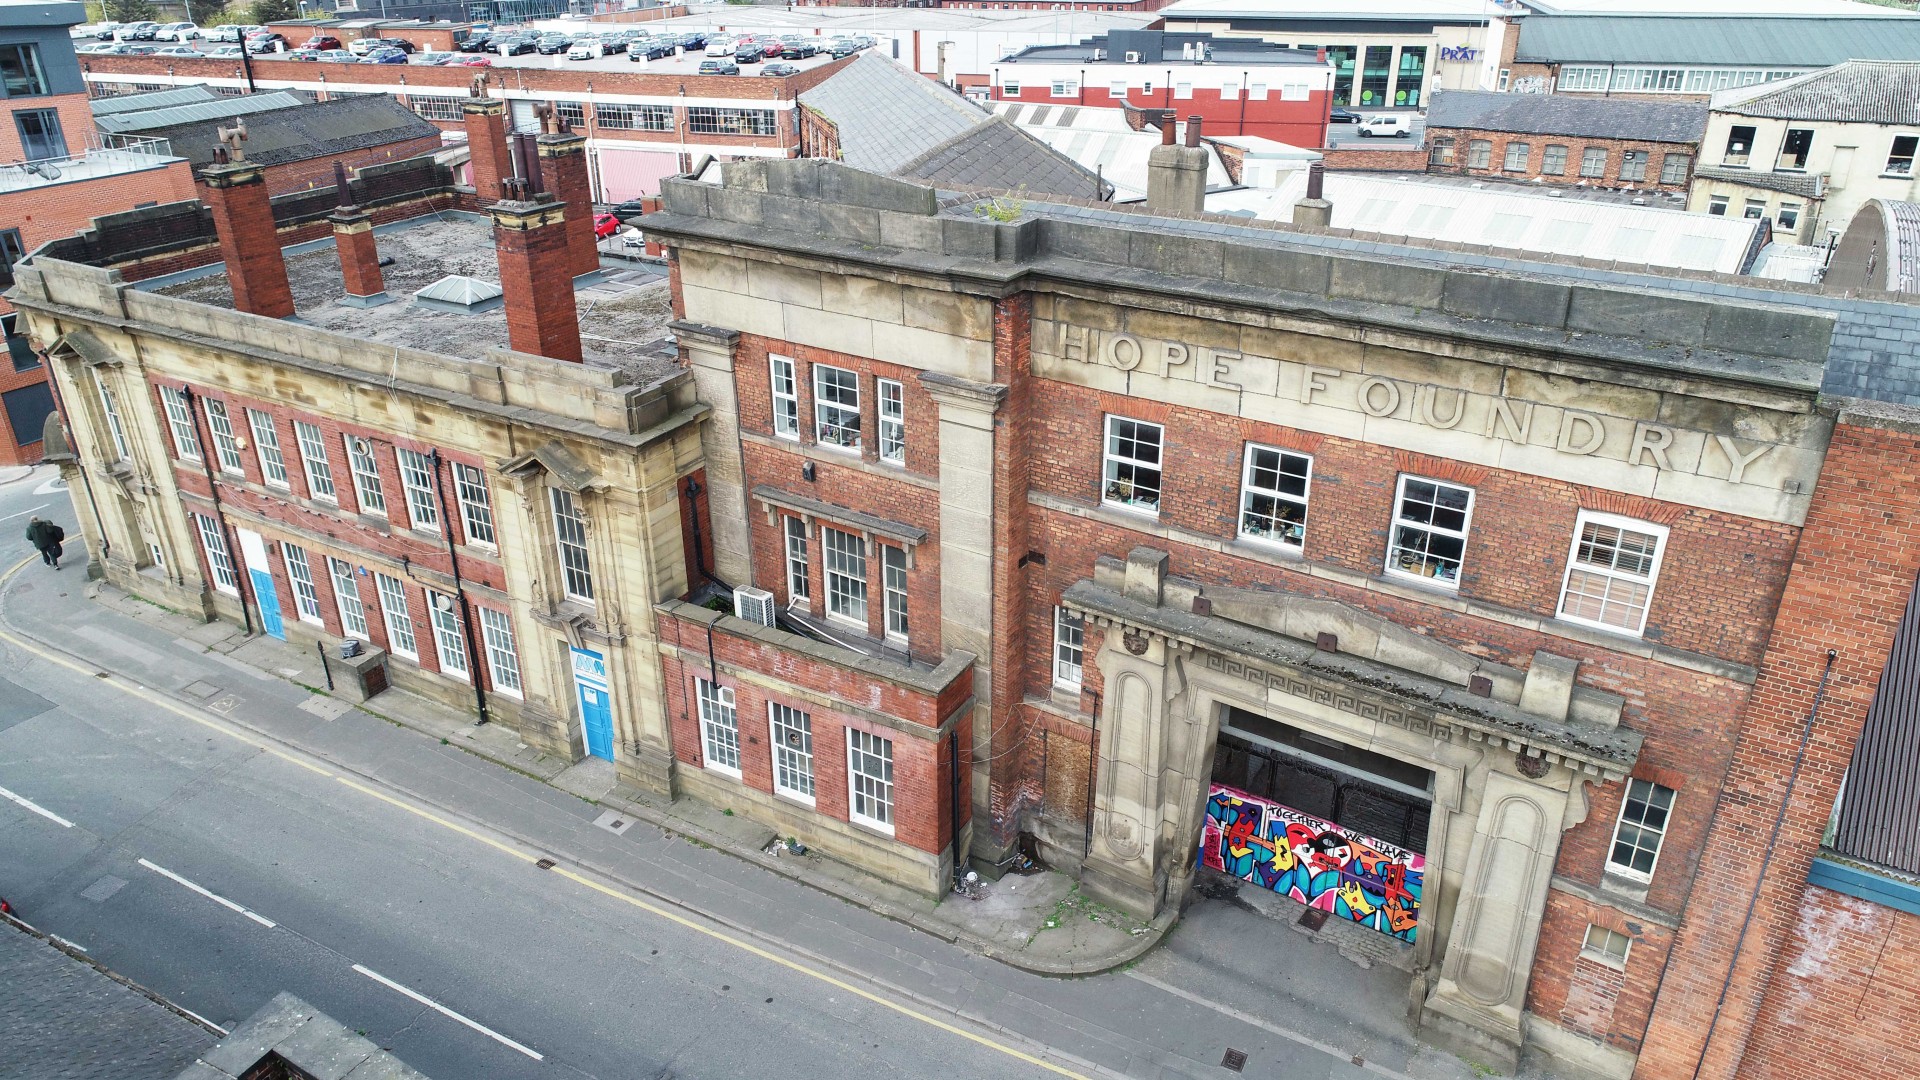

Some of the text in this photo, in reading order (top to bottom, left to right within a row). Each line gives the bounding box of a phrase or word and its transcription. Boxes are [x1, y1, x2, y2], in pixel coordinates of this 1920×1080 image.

[1059, 323, 1776, 484] HOPE FOUNDRY
[1267, 806, 1411, 859] TOGETHER WE HAVE
